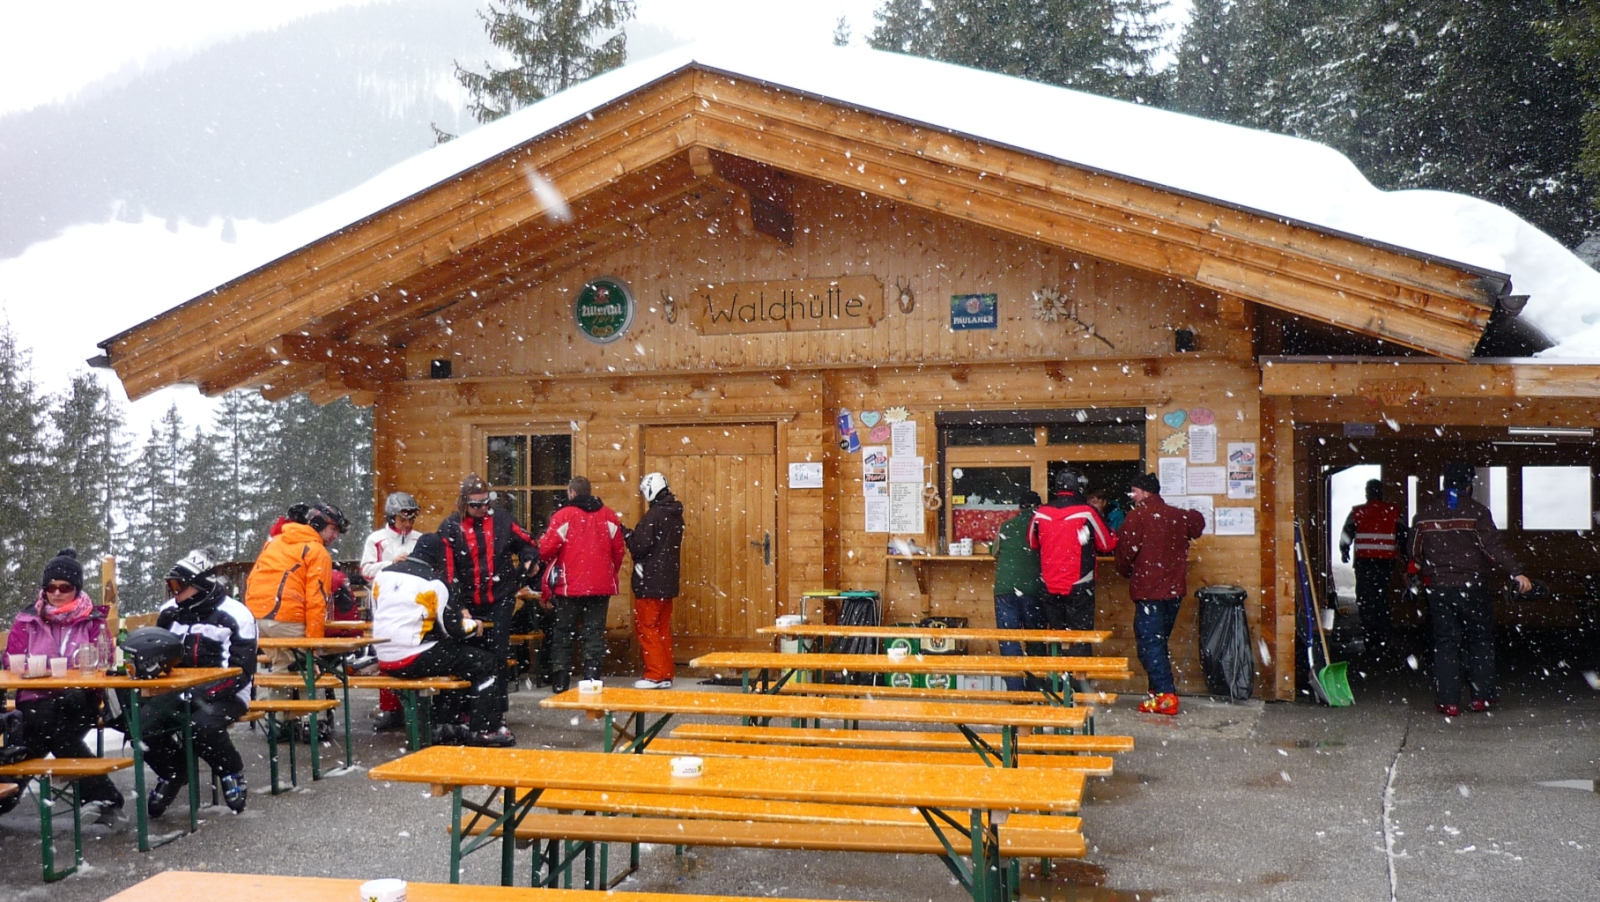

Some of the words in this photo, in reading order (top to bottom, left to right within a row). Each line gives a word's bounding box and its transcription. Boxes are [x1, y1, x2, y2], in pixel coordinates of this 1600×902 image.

[705, 288, 863, 324] Waldhütte
[953, 315, 993, 325] PAULANER
[1218, 508, 1232, 517] WC
